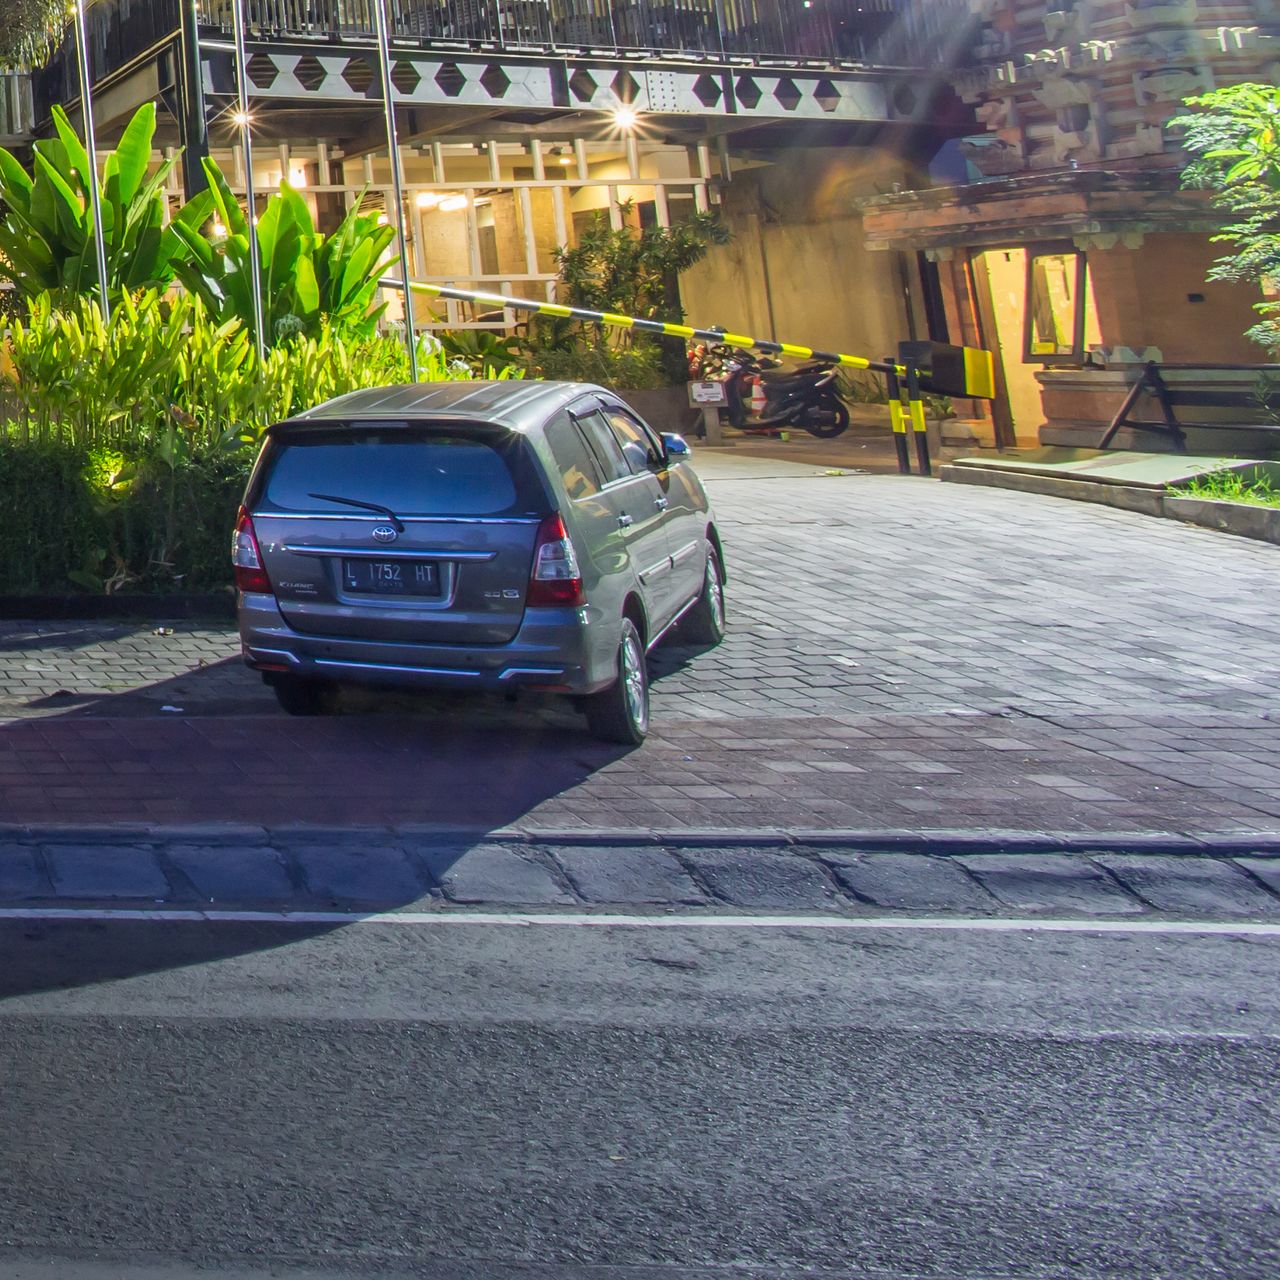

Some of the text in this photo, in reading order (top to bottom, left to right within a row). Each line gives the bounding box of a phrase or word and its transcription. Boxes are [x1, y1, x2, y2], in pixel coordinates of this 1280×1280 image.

[347, 563, 433, 582] L 1752 HT
